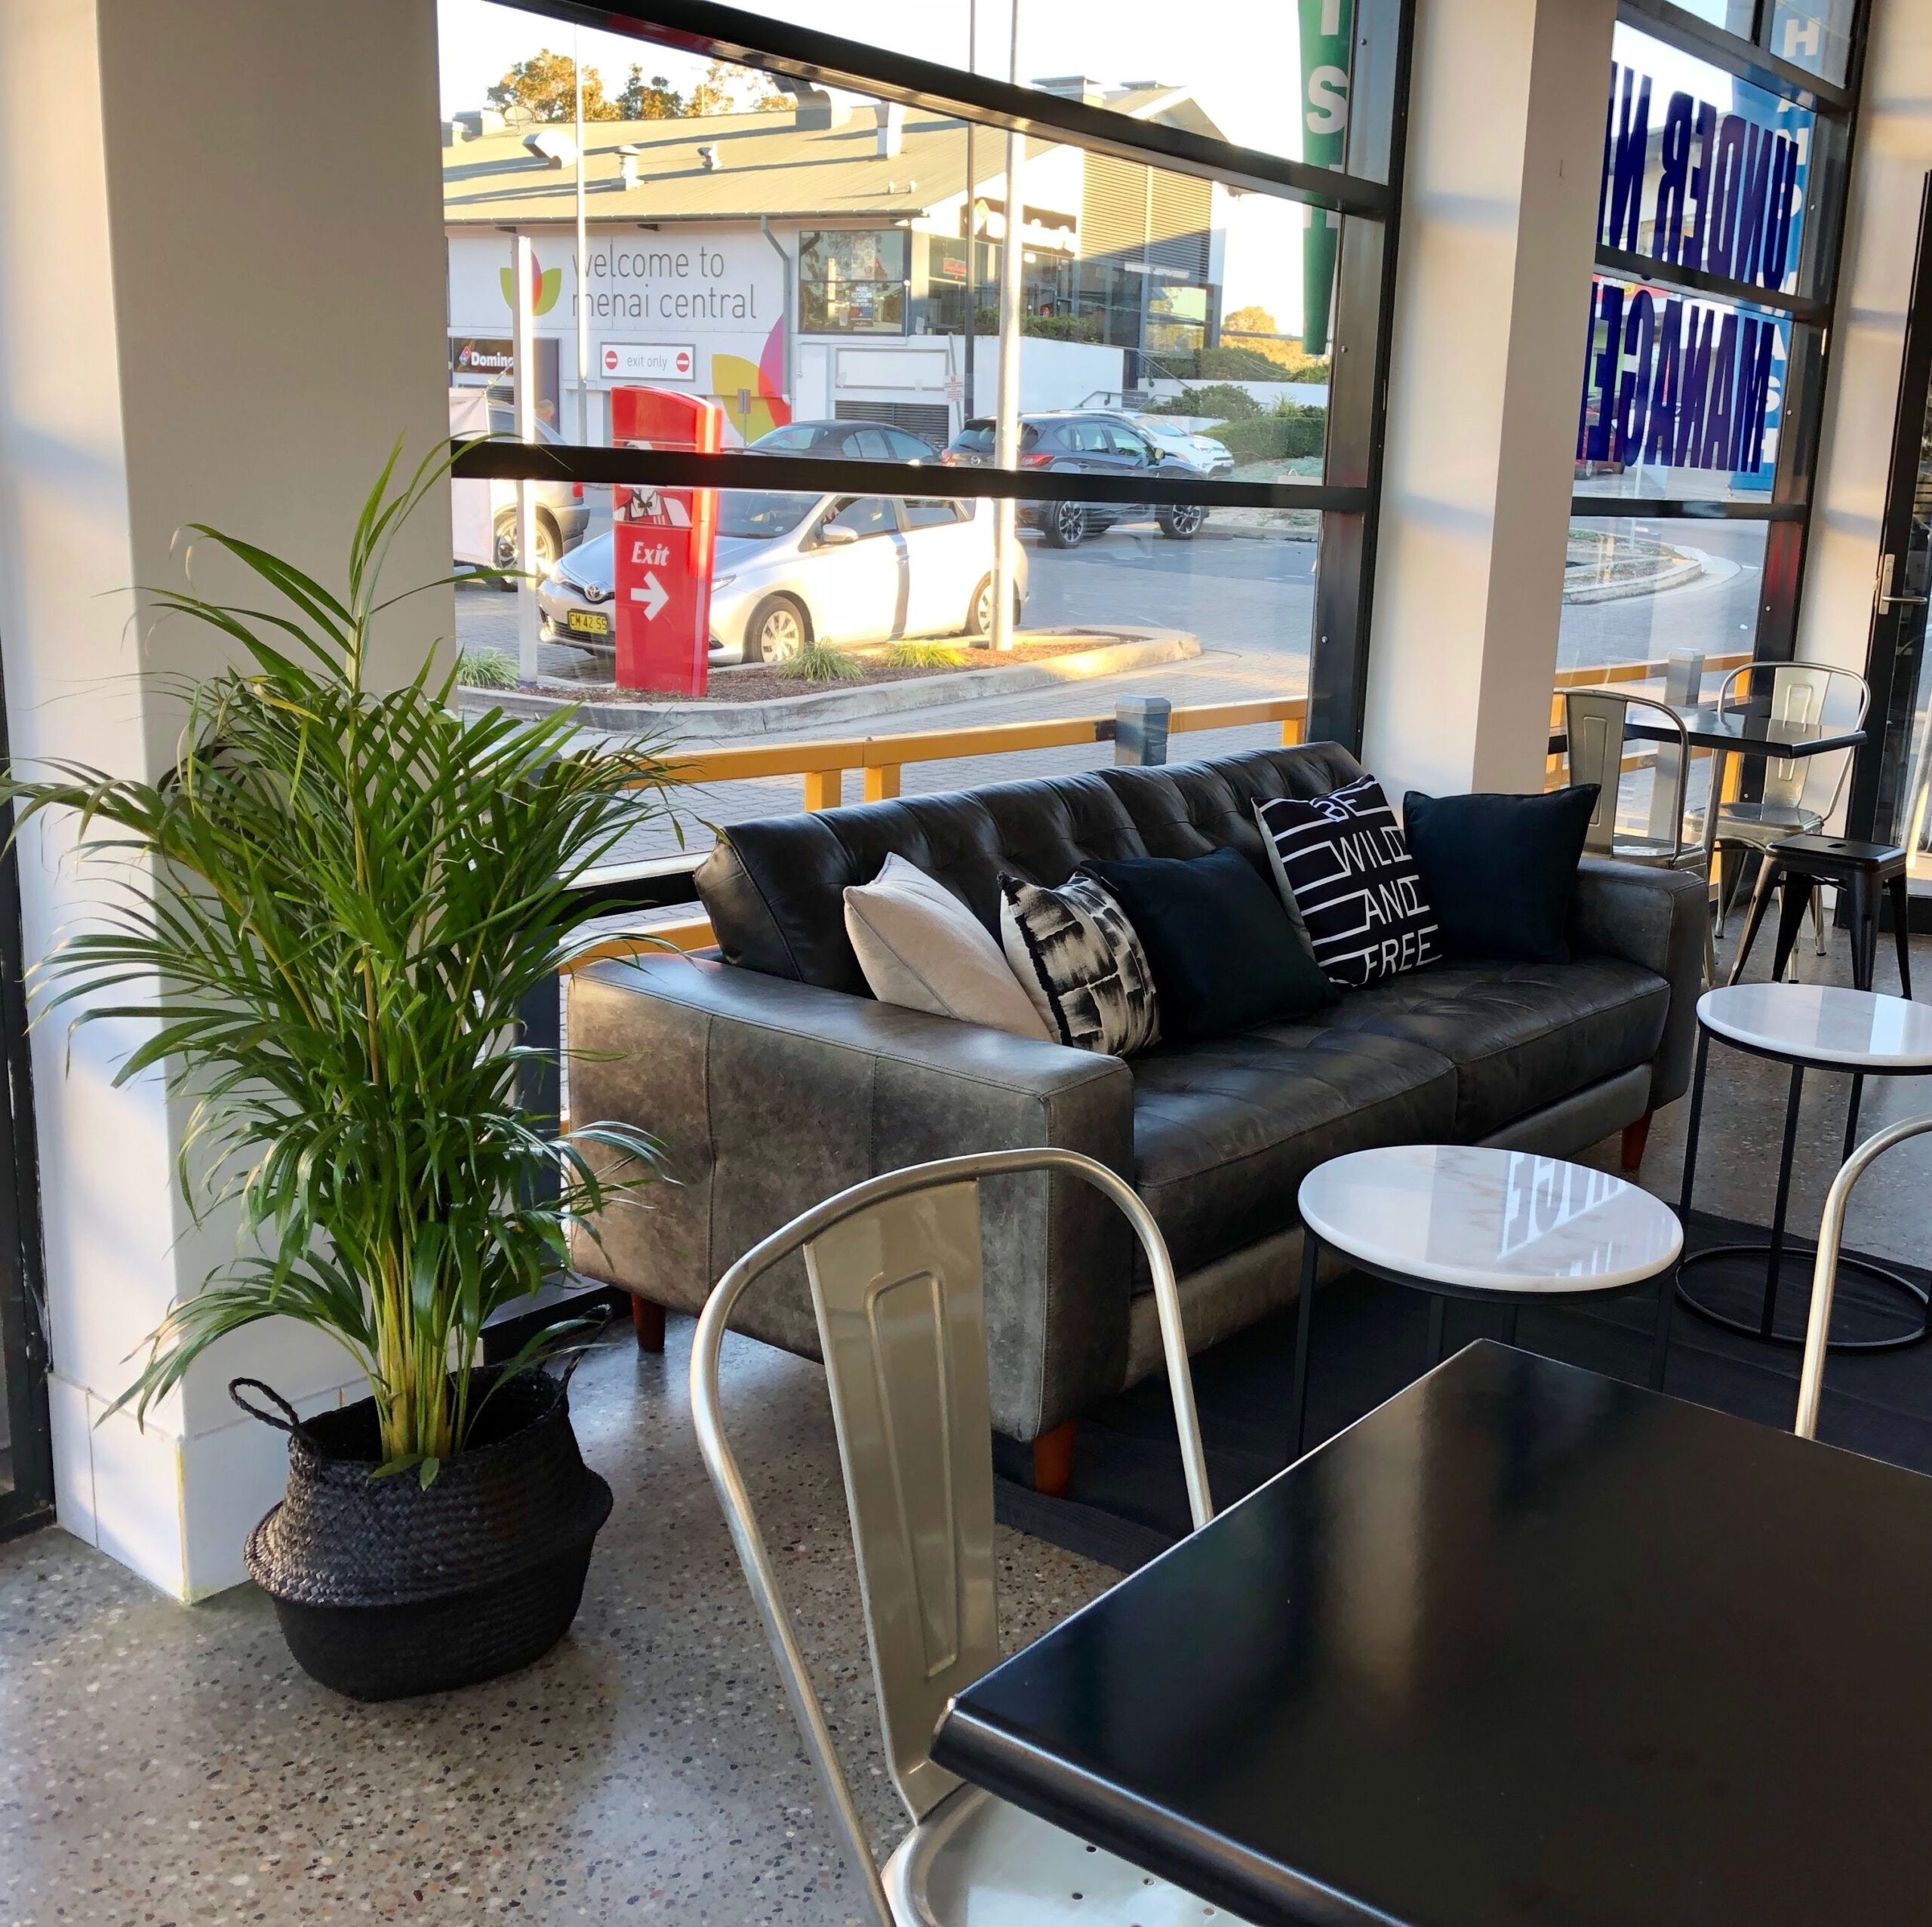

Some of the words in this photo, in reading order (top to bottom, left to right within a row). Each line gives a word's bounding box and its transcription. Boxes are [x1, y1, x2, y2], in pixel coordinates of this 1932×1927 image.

[572, 244, 689, 278] welcome
[699, 246, 724, 278] to
[572, 284, 649, 318] menai
[660, 284, 757, 318] central
[627, 354, 645, 367] exit
[647, 355, 668, 371] only
[631, 541, 670, 566] Exit
[1328, 825, 1413, 875] WILD
[1363, 874, 1431, 930] AND
[1359, 924, 1443, 985] FREE
